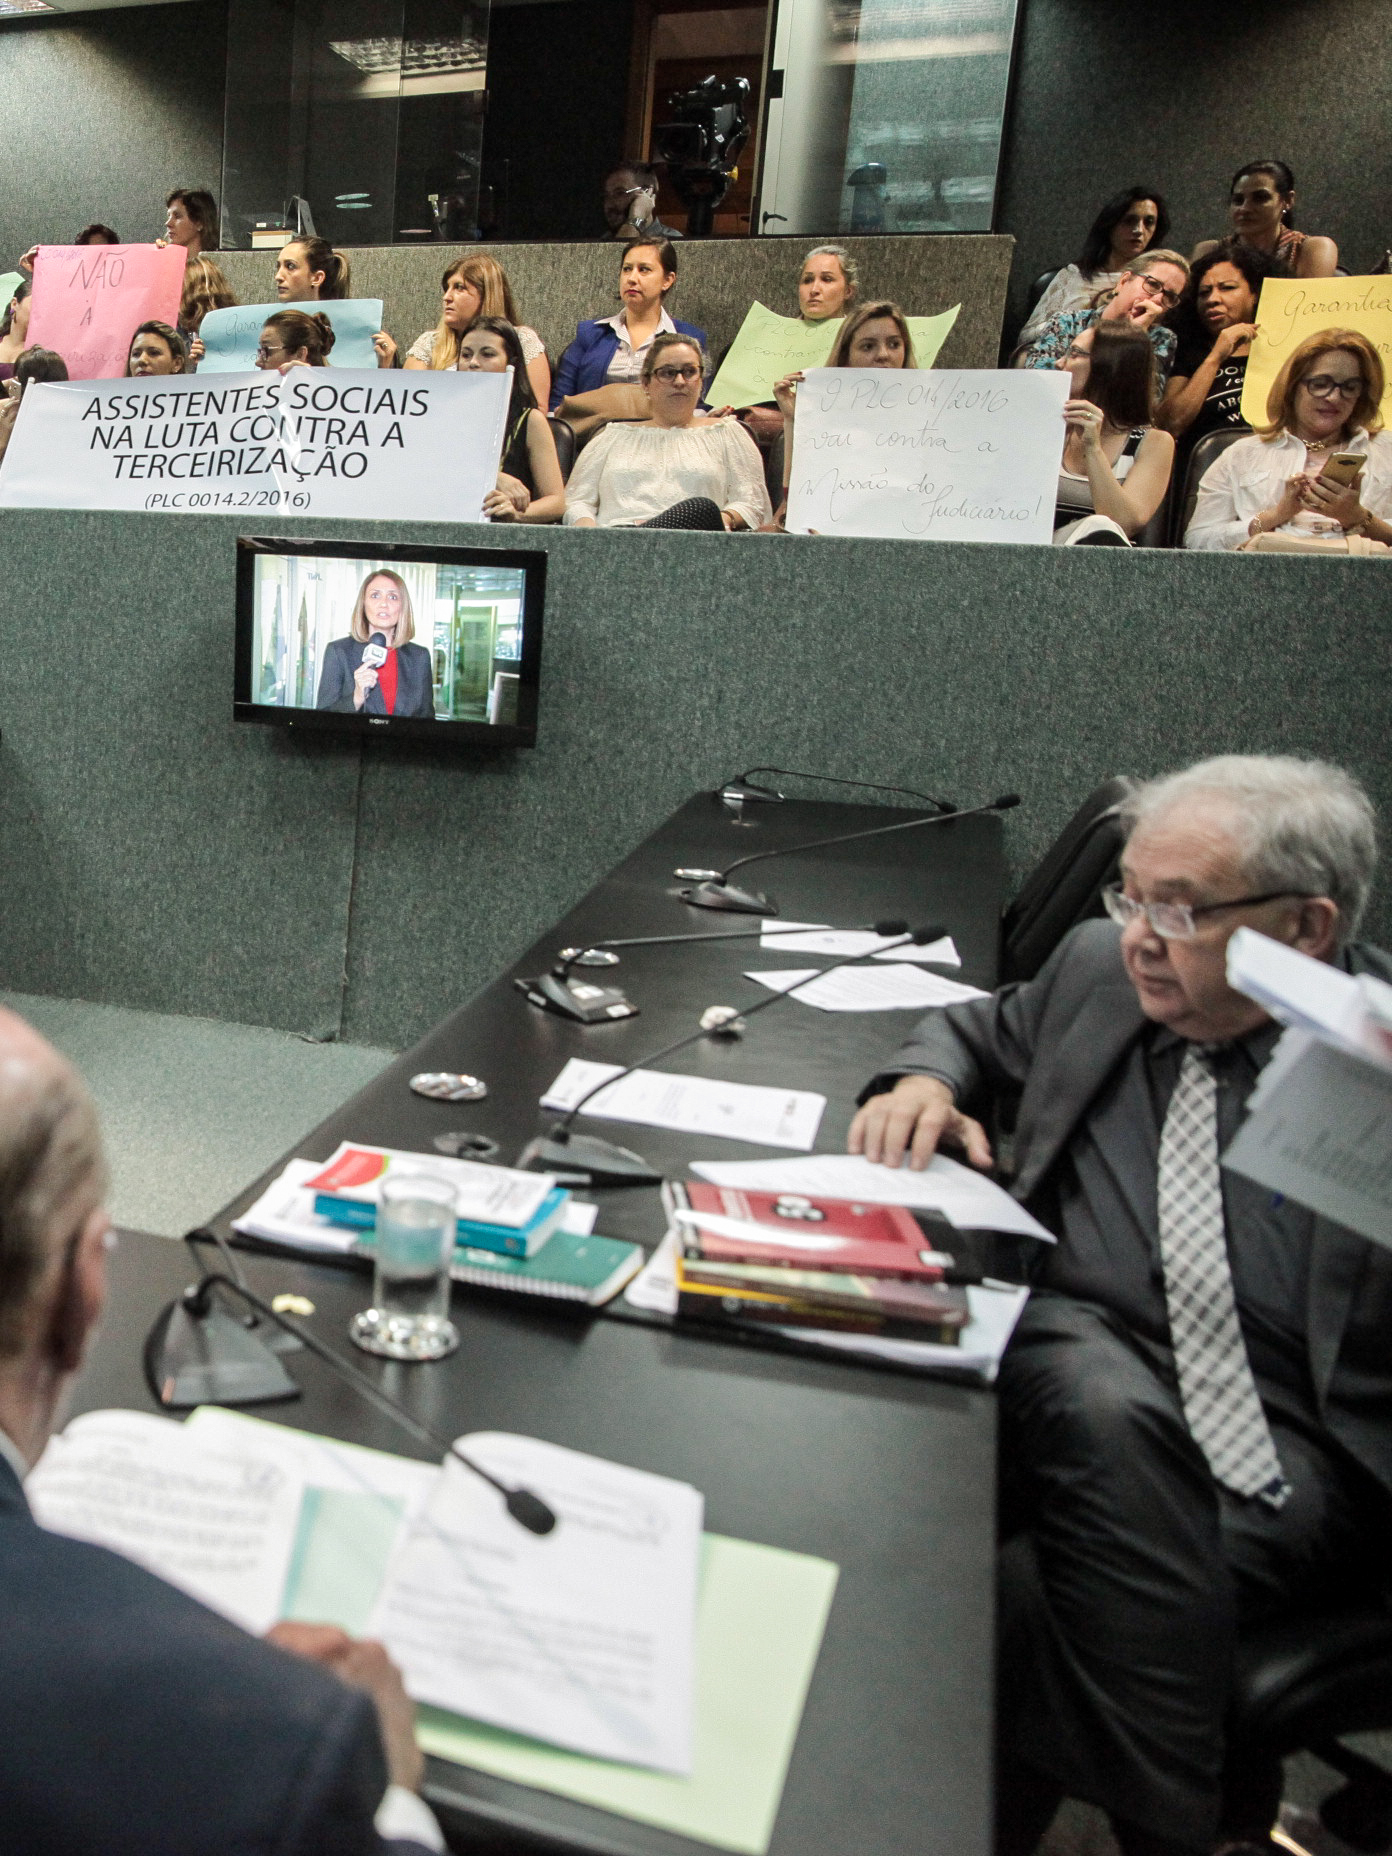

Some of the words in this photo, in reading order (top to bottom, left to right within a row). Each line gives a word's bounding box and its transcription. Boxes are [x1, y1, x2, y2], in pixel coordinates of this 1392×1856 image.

[69, 249, 128, 290] NÃO
[81, 384, 281, 421] ASSISTENTES
[289, 383, 430, 417] SOCIAIS
[850, 377, 903, 410] PLC
[90, 425, 134, 450] NA
[144, 421, 219, 449] LUTA
[230, 415, 370, 447] CONTRA
[380, 421, 405, 449] A
[875, 420, 961, 453] contra
[977, 441, 1001, 453] a
[113, 445, 369, 483] TERCEIRIZAÇÃO
[144, 493, 186, 510] (PLC
[188, 490, 312, 510] 0014.2/2016)
[906, 473, 935, 495] do
[368, 717, 391, 726] SONY
